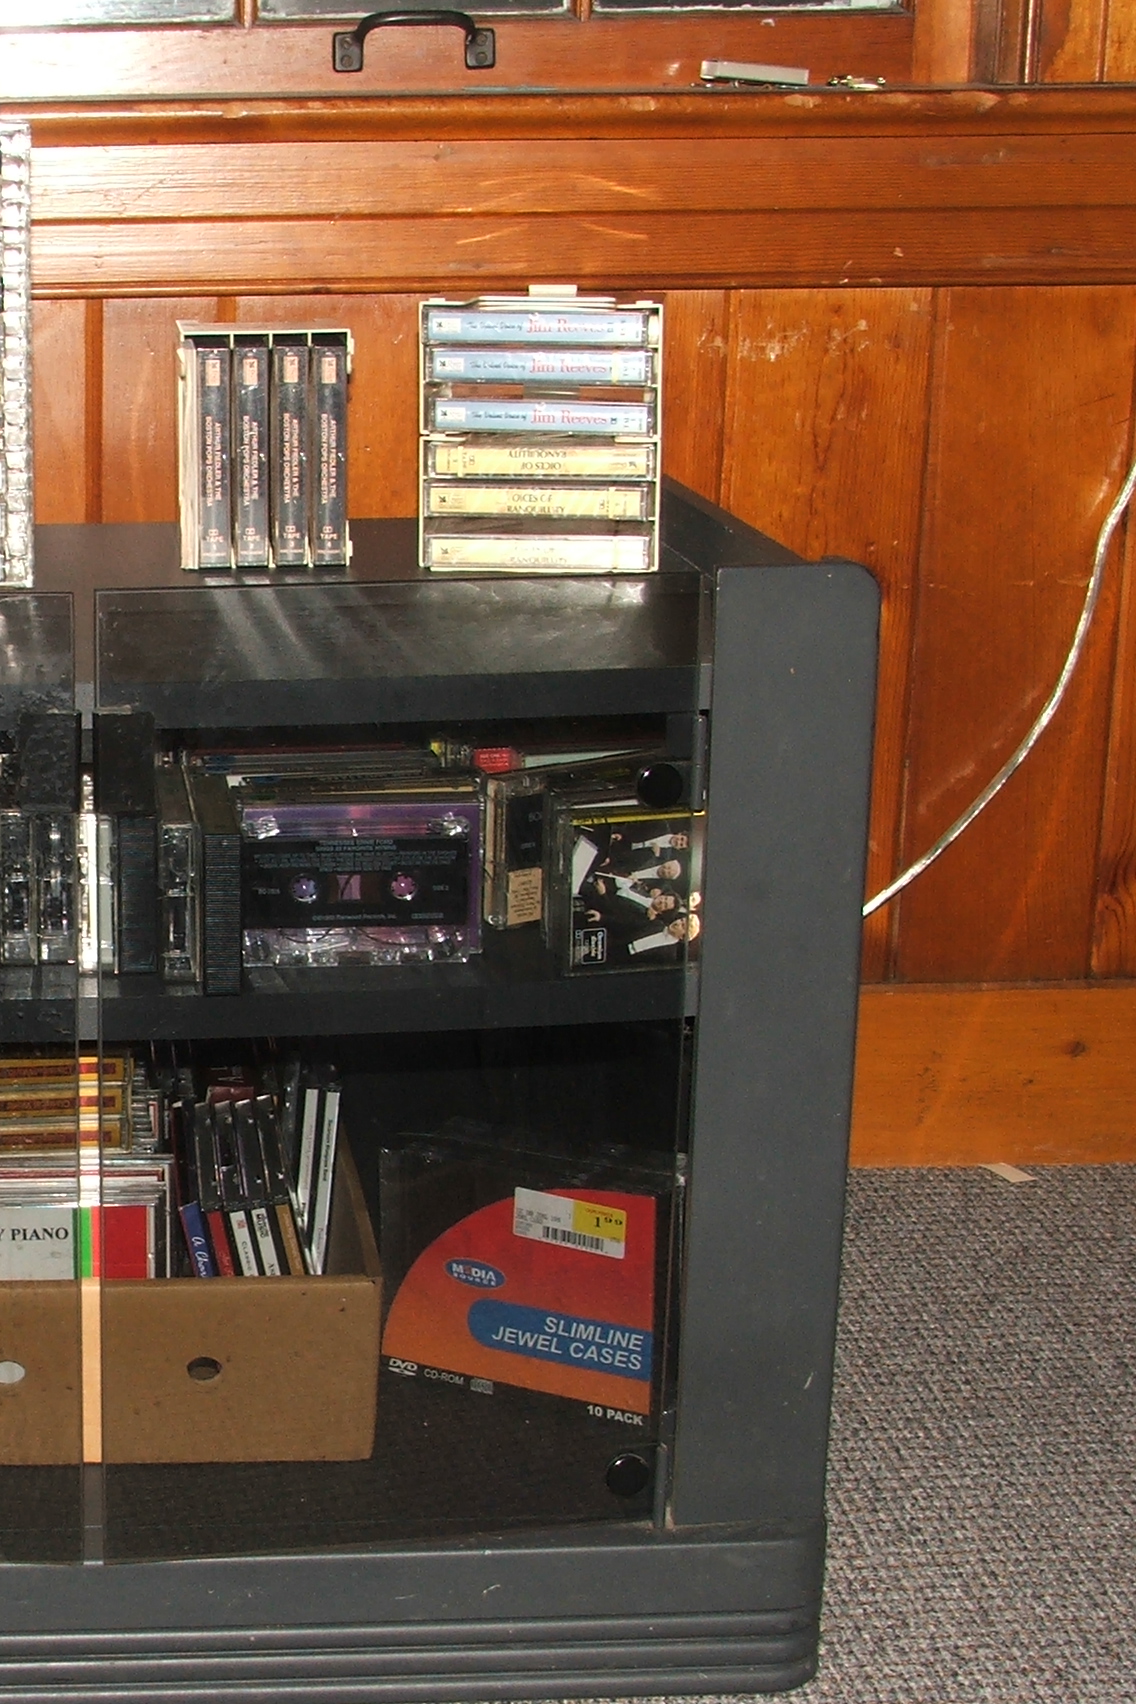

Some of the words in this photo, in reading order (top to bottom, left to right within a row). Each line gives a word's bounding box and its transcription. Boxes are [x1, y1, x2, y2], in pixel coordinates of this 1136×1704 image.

[527, 318, 552, 334] Jim
[558, 318, 605, 334] Reeves
[530, 358, 555, 373] Jim
[560, 359, 606, 373] Reeves
[531, 409, 555, 425] Jim
[561, 410, 607, 425] Reeves
[521, 462, 533, 470] OF
[11, 1226, 70, 1242] PIANO
[451, 1262, 497, 1281] MEDIA
[453, 1272, 497, 1287] SOURCE
[544, 1316, 644, 1352] SLIMLINE
[492, 1326, 562, 1355] JEWEL
[569, 1342, 642, 1371] CASES
[388, 1358, 418, 1371] DVD
[424, 1368, 465, 1387] CD-ROM
[586, 1404, 603, 1417] 10
[606, 1408, 644, 1426] PACK
